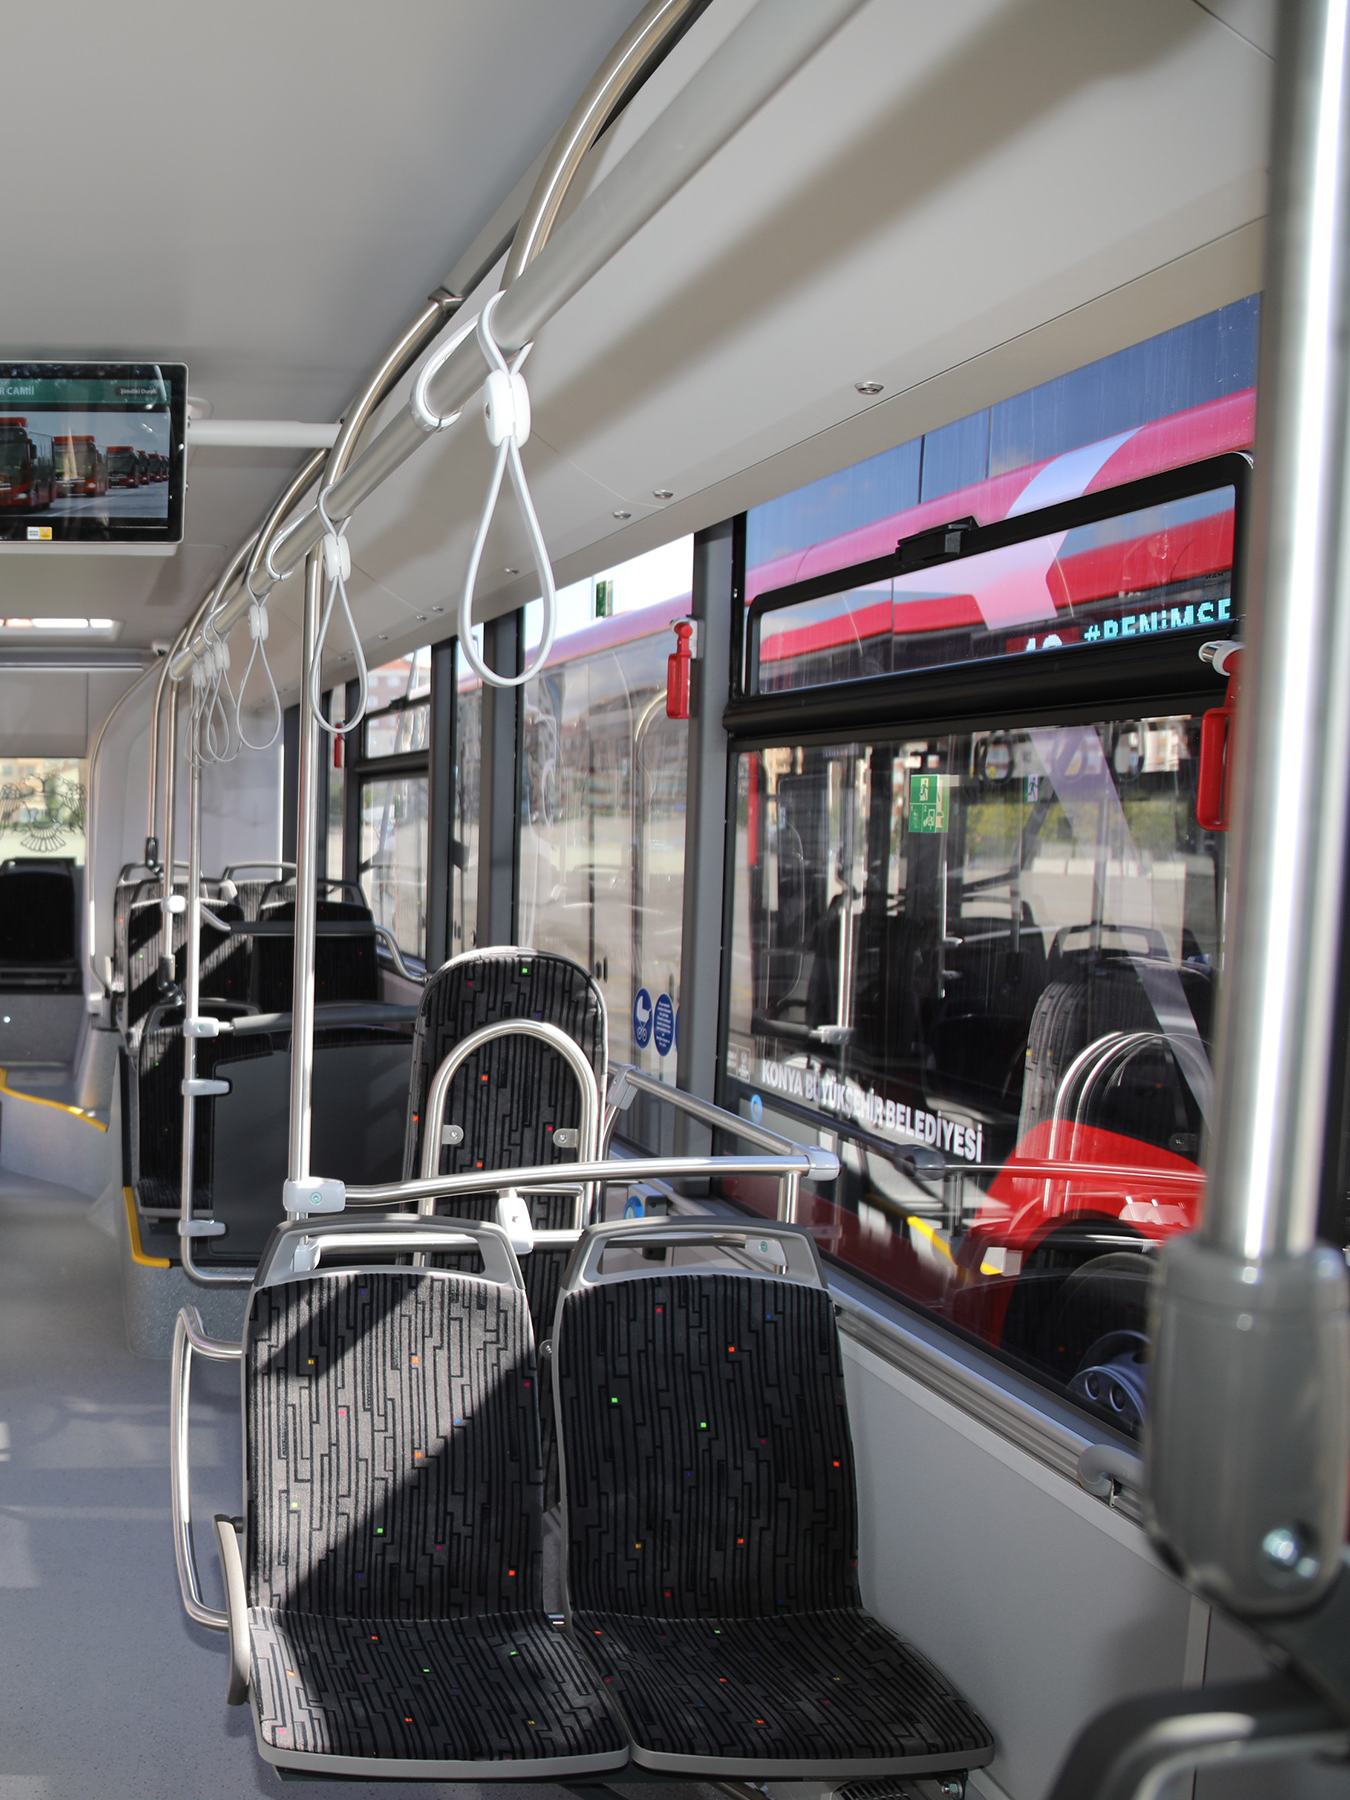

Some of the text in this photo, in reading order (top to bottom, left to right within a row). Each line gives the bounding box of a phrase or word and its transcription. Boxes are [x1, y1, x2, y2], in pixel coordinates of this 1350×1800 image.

[762, 1059, 983, 1163] KONYA BÜYÜKŞEHİR BELEDİYESİ
